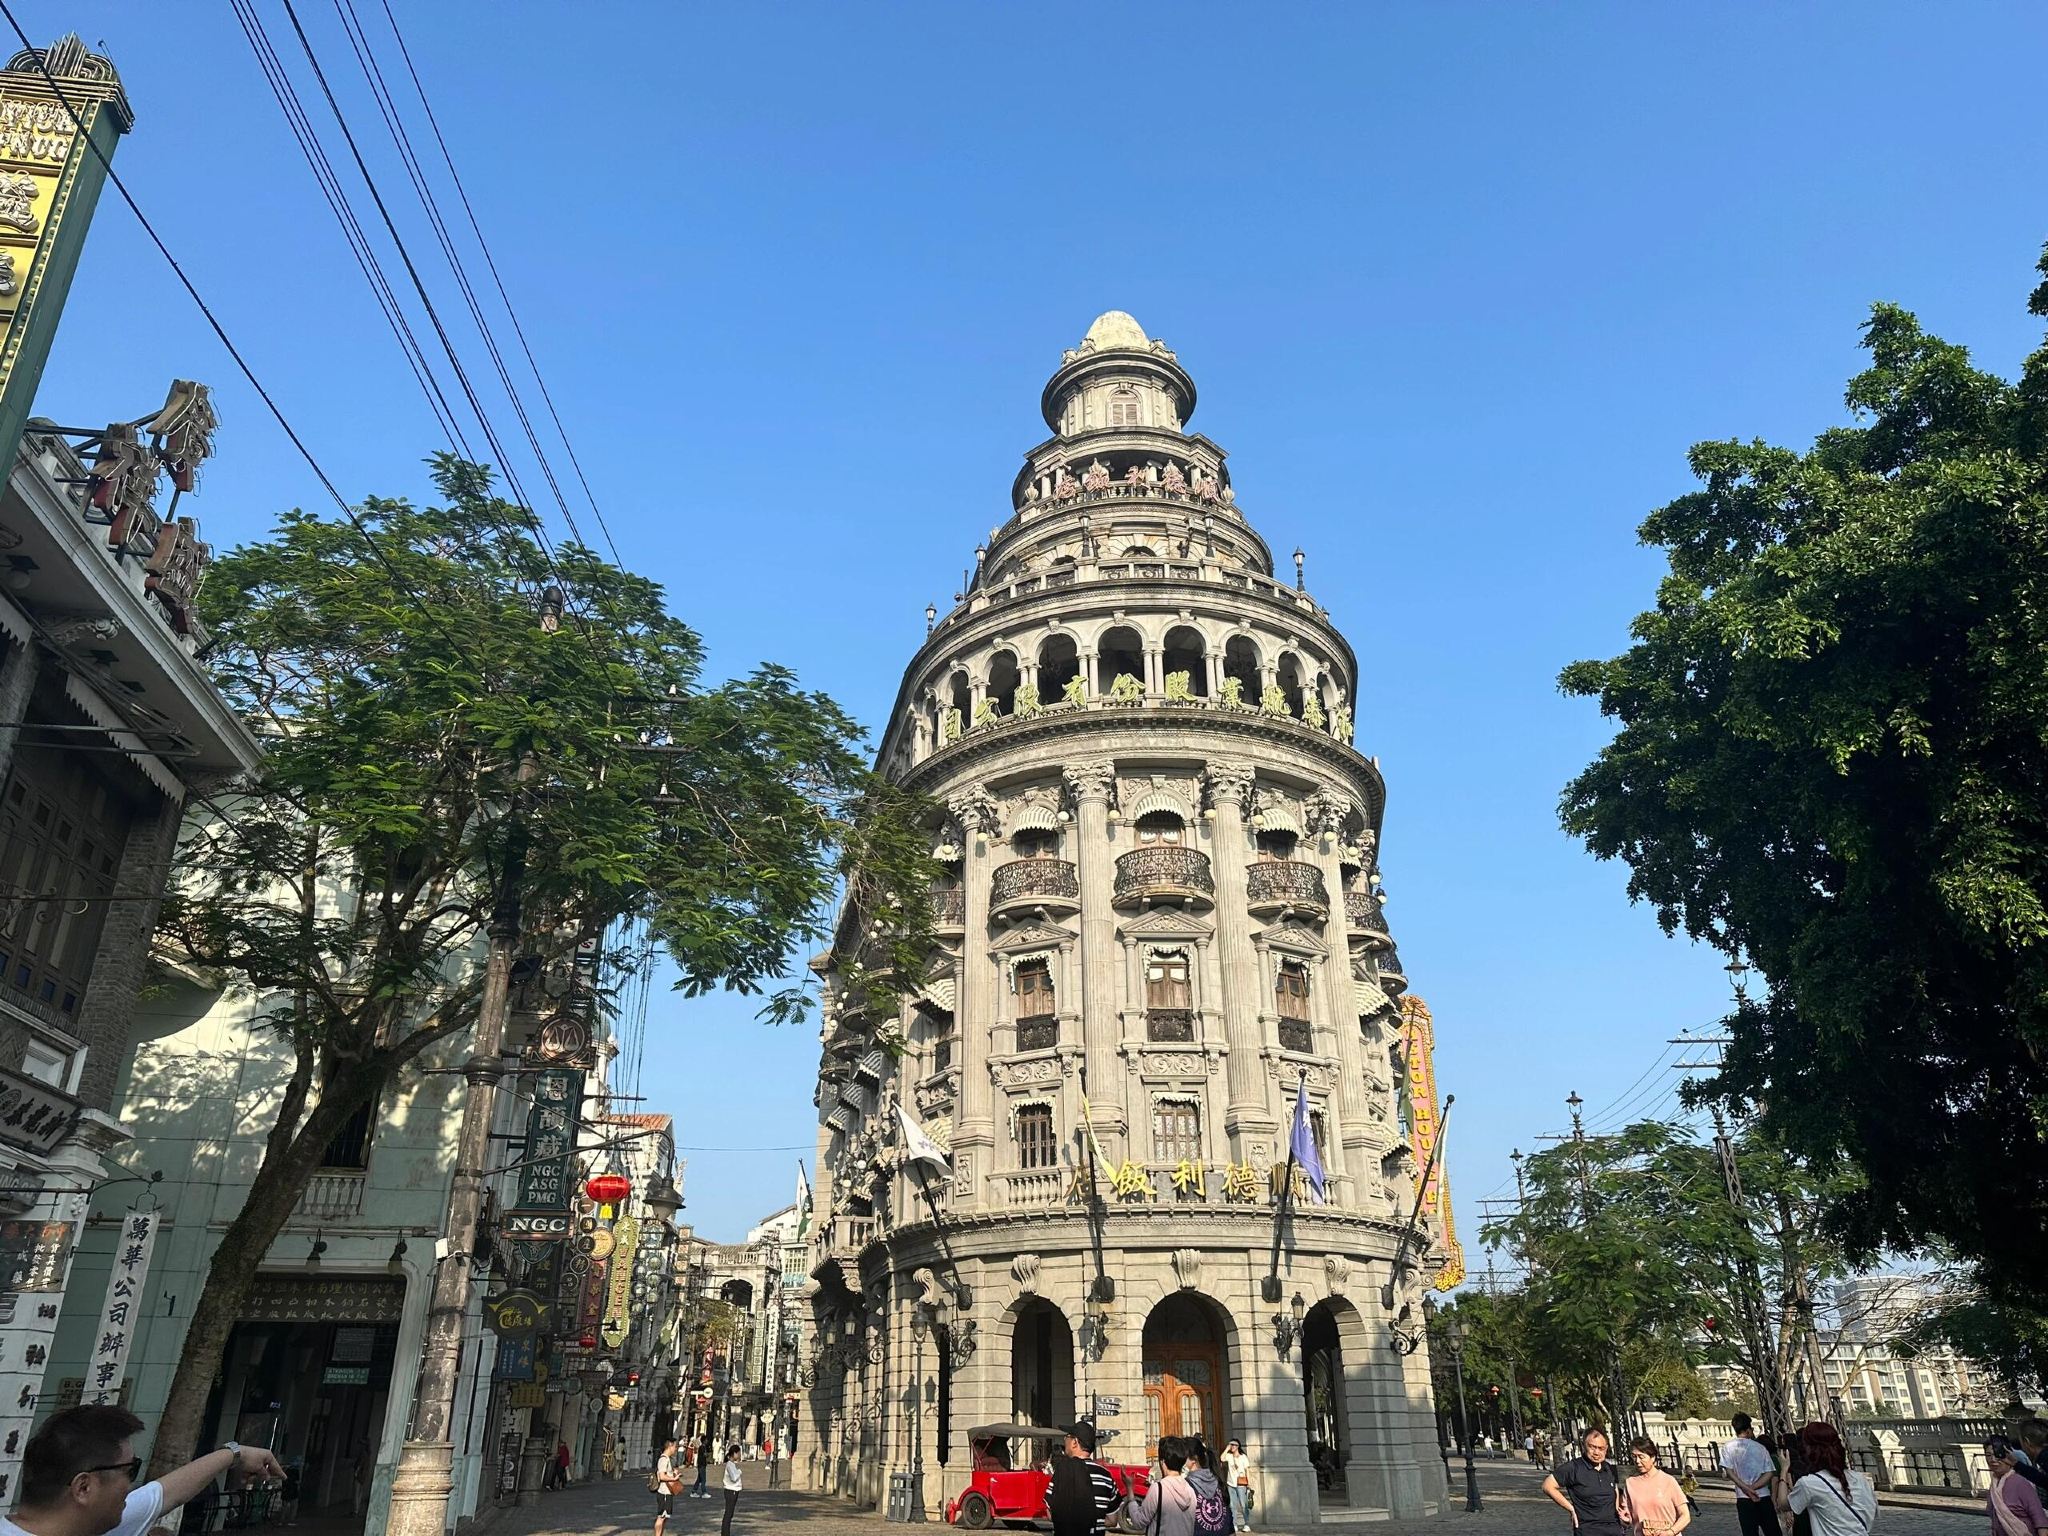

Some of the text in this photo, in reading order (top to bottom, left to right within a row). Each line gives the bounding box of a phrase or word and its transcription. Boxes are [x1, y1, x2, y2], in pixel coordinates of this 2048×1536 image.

[531, 1165, 560, 1178] NGC
[529, 1177, 558, 1190] ASG
[528, 1191, 556, 1203] PMG
[510, 1218, 566, 1232] NGC
